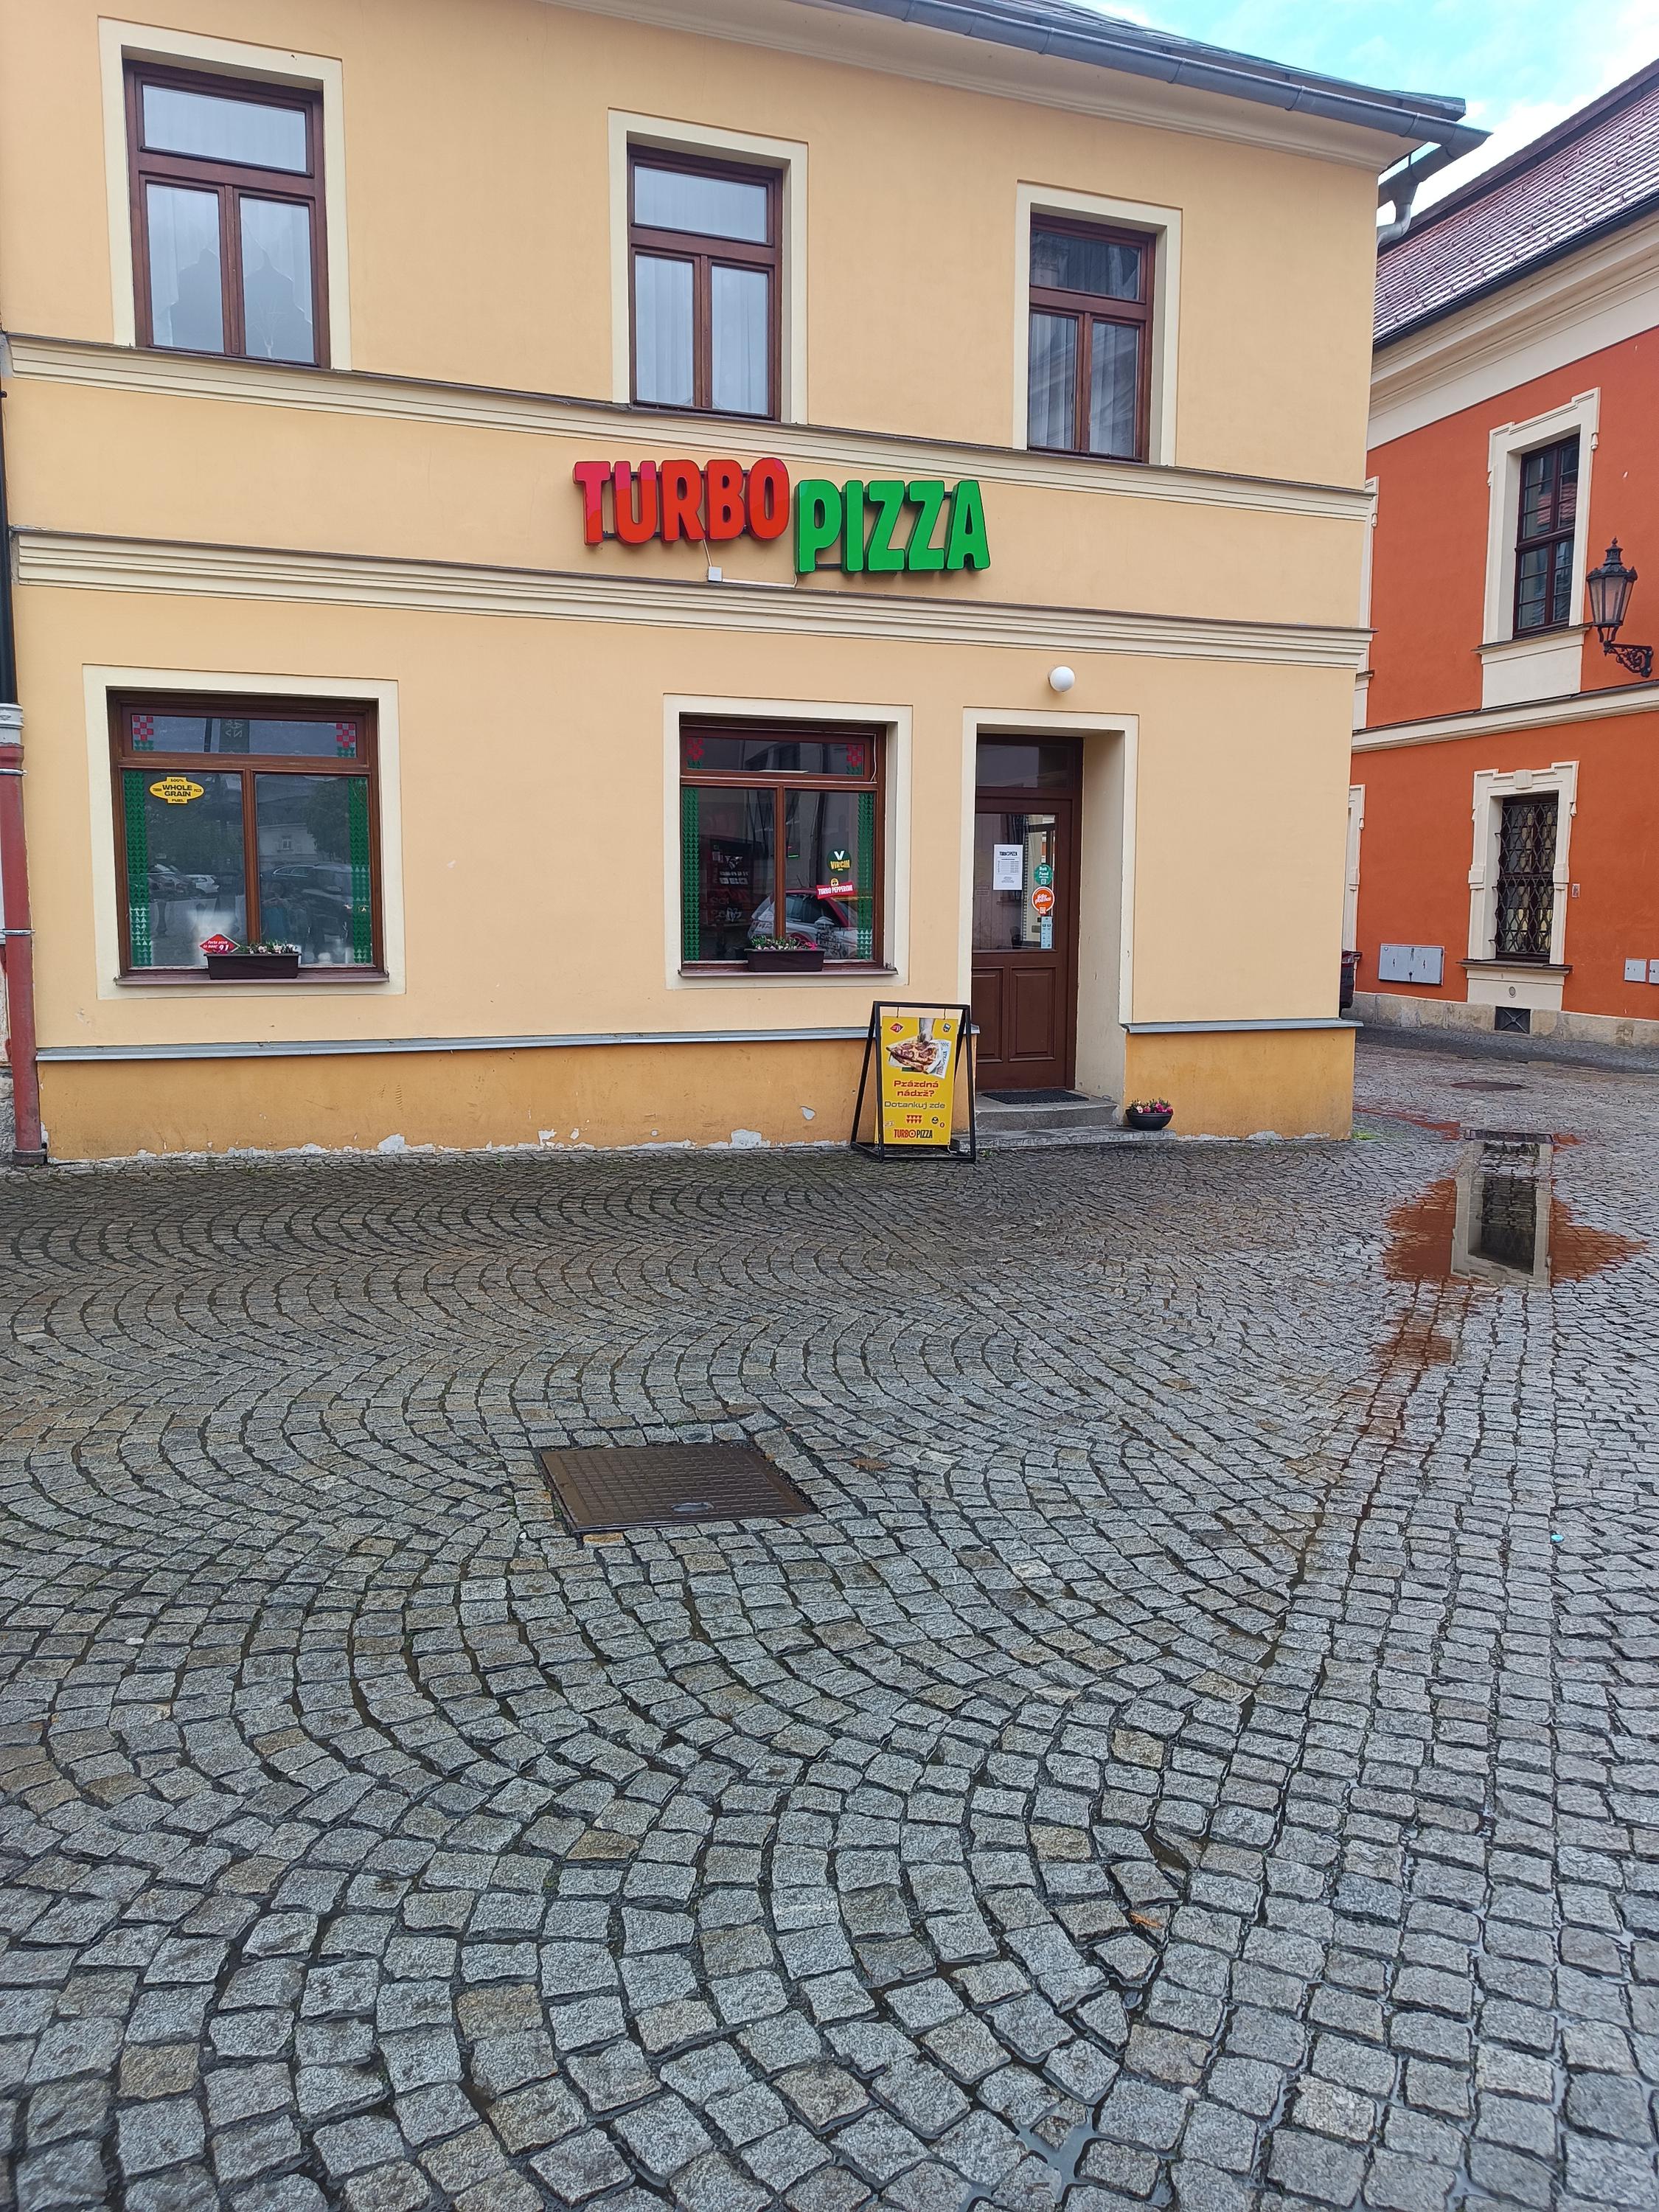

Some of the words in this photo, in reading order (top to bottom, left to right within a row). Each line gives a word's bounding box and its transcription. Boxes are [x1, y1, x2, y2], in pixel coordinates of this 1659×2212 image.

[574, 457, 790, 546] TURBO
[793, 479, 991, 574] PIZZA
[830, 859, 850, 870] VIRGIN
[894, 1079, 939, 1088] Prázdná
[897, 1089, 935, 1097] nádrž?
[884, 1101, 928, 1110] Dotankuj
